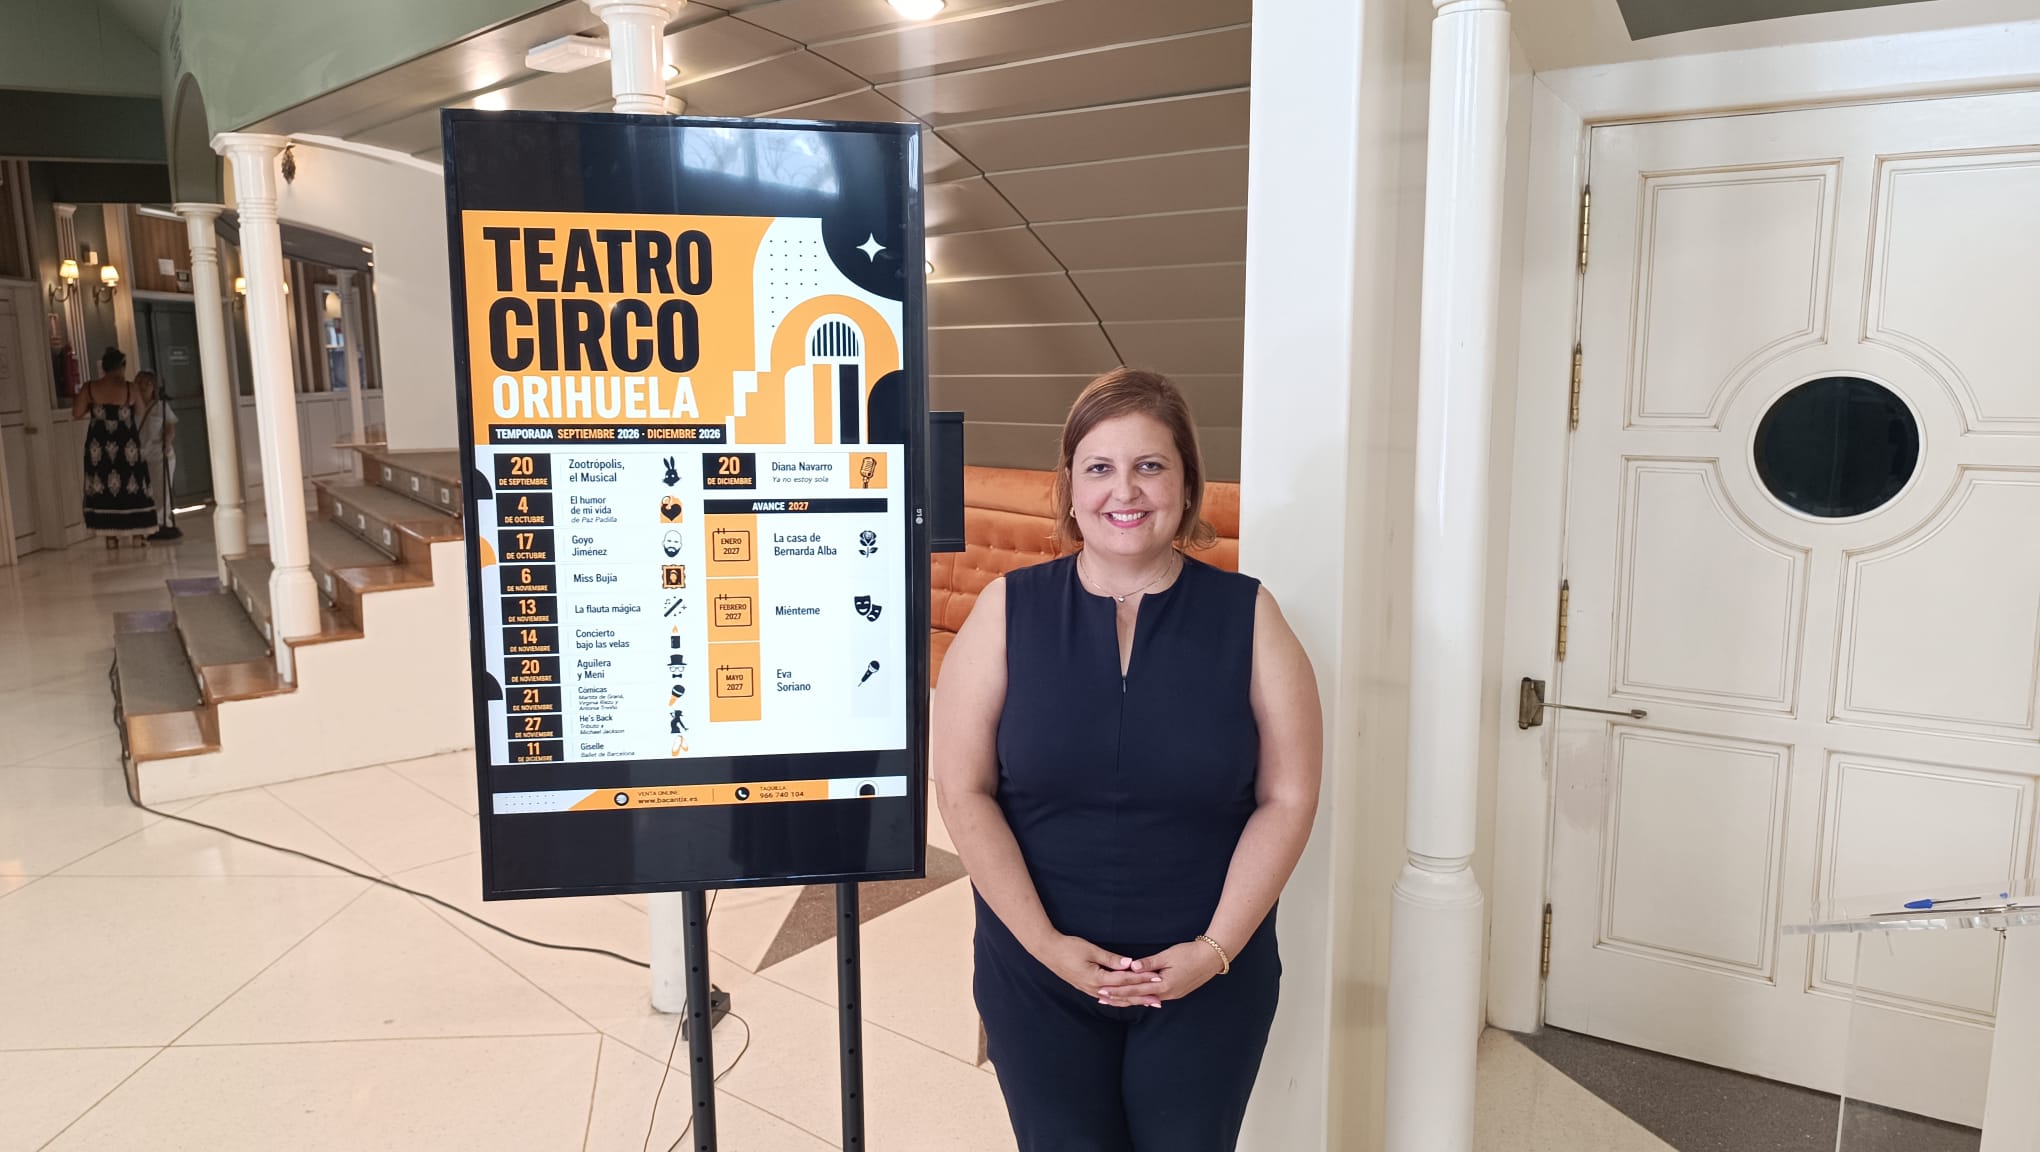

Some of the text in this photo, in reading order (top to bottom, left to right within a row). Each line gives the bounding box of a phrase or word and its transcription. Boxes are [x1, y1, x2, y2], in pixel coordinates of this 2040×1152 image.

[483, 226, 712, 295] TEATRO
[489, 297, 700, 372] CIRCO
[492, 375, 700, 418] ORIHUELA
[496, 428, 553, 440] TEMPORADA
[558, 428, 615, 440] SEPTIEMBRE
[618, 428, 640, 440] 2026
[648, 428, 696, 440] DICIEMBRE
[698, 428, 720, 440] 2026
[510, 456, 534, 475] 20
[568, 458, 624, 471] Zootrópolis,
[718, 456, 740, 474] 20
[772, 462, 832, 471] Diana Navarro
[570, 472, 617, 482] el Musical
[717, 477, 752, 485] DICIEMBRE
[794, 476, 812, 484] estoy
[518, 496, 528, 513] 4
[570, 496, 606, 504] El humor
[570, 506, 612, 514] de mi vida
[752, 502, 808, 511] AVANCE 2027
[516, 532, 534, 550] 17
[572, 534, 594, 546] Goyo
[774, 532, 820, 542] La casa de
[572, 546, 608, 556] Jiménez
[723, 547, 740, 555] 2027
[774, 546, 837, 556] Bernarda Alba
[521, 568, 532, 584] 6
[574, 573, 594, 582] Miss
[519, 599, 536, 614] 13
[574, 604, 641, 614] La flauta mágica
[776, 605, 820, 616] Miénteme
[520, 629, 538, 644] 14
[576, 628, 614, 638] Concierto
[576, 640, 630, 651] bajo las velas
[522, 660, 540, 674] 20
[577, 658, 612, 670] Aguilera
[577, 670, 604, 681] y Meni
[776, 669, 792, 678] Eva
[776, 682, 811, 692] Soriano
[523, 688, 539, 703] 21
[580, 714, 613, 722] He's Back
[524, 717, 542, 731] 27
[527, 742, 540, 755] 11
[580, 742, 604, 750] Giselle
